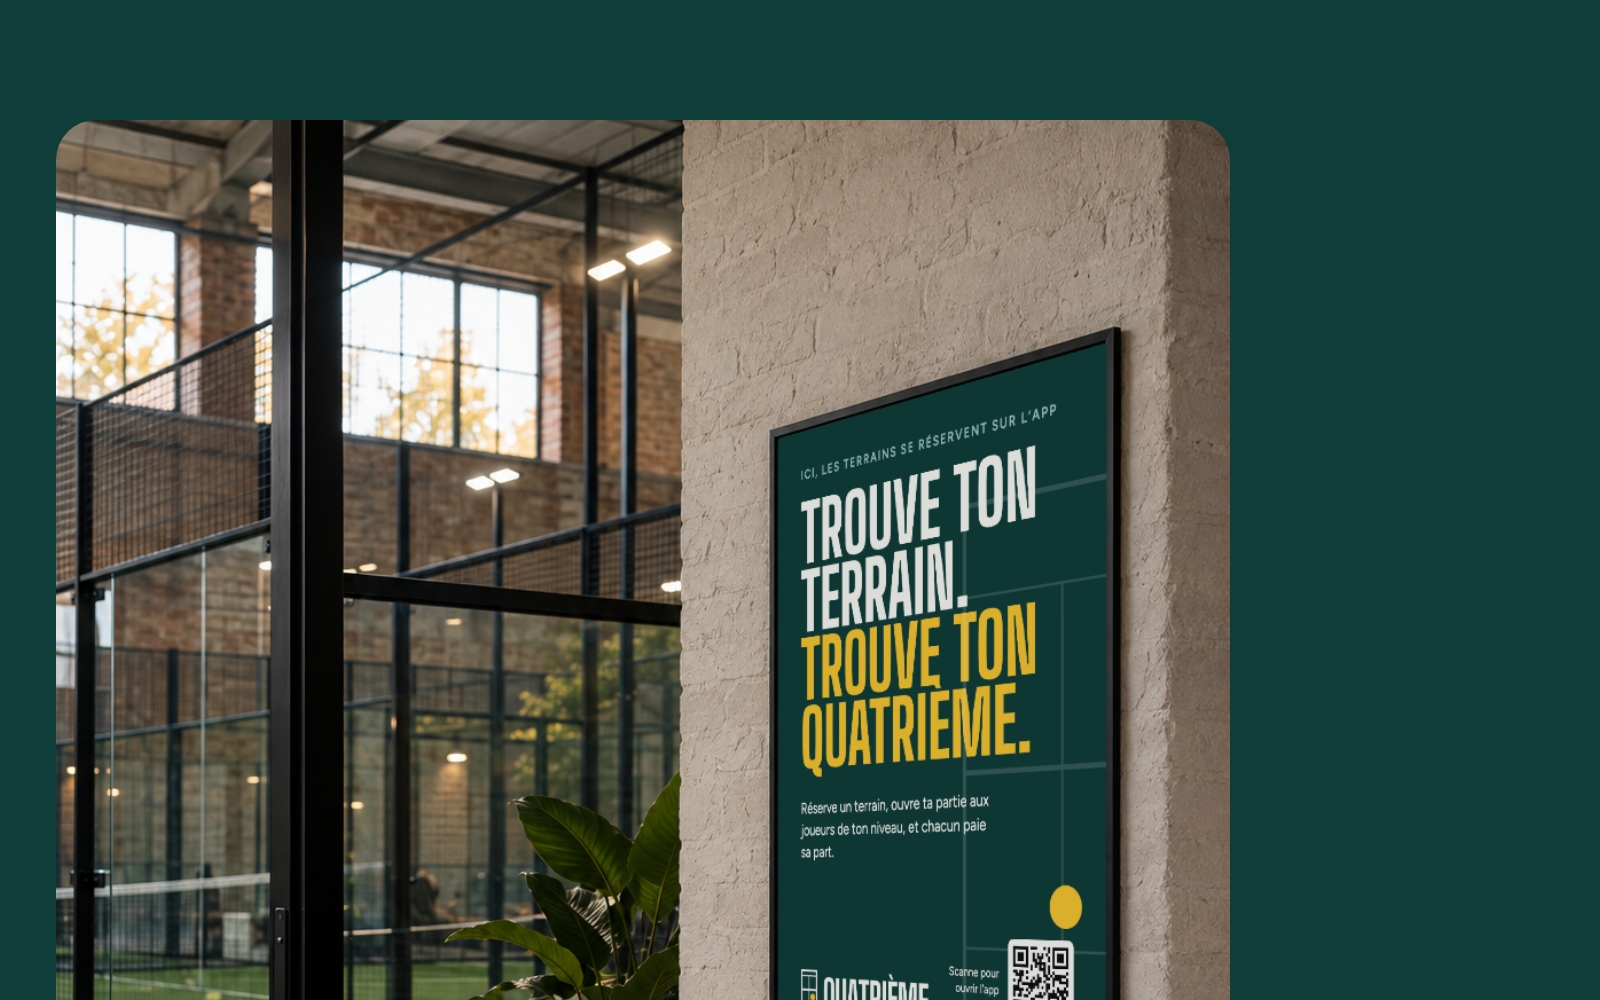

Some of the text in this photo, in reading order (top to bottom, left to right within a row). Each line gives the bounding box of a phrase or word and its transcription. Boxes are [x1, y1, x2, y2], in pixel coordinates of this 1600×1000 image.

[801, 467, 818, 480] ICI,
[822, 461, 839, 475] LES
[843, 446, 896, 469] TERRAINS
[900, 441, 913, 455] SE
[918, 422, 987, 450] RÉSERVENT
[992, 415, 1016, 431] SUR
[801, 445, 1036, 564] TROUVE TON
[801, 540, 968, 632] TERRAIN.
[801, 602, 1036, 700] TROUVE TON
[801, 795, 989, 815] Réserve un terrain, ouvre ta partie aux
[800, 818, 987, 840] joueurs de ton niveau, et chacun paie
[801, 846, 834, 861] sa part.
[948, 966, 1000, 980] Scanne pour
[955, 983, 999, 997] ouvrir l'app
